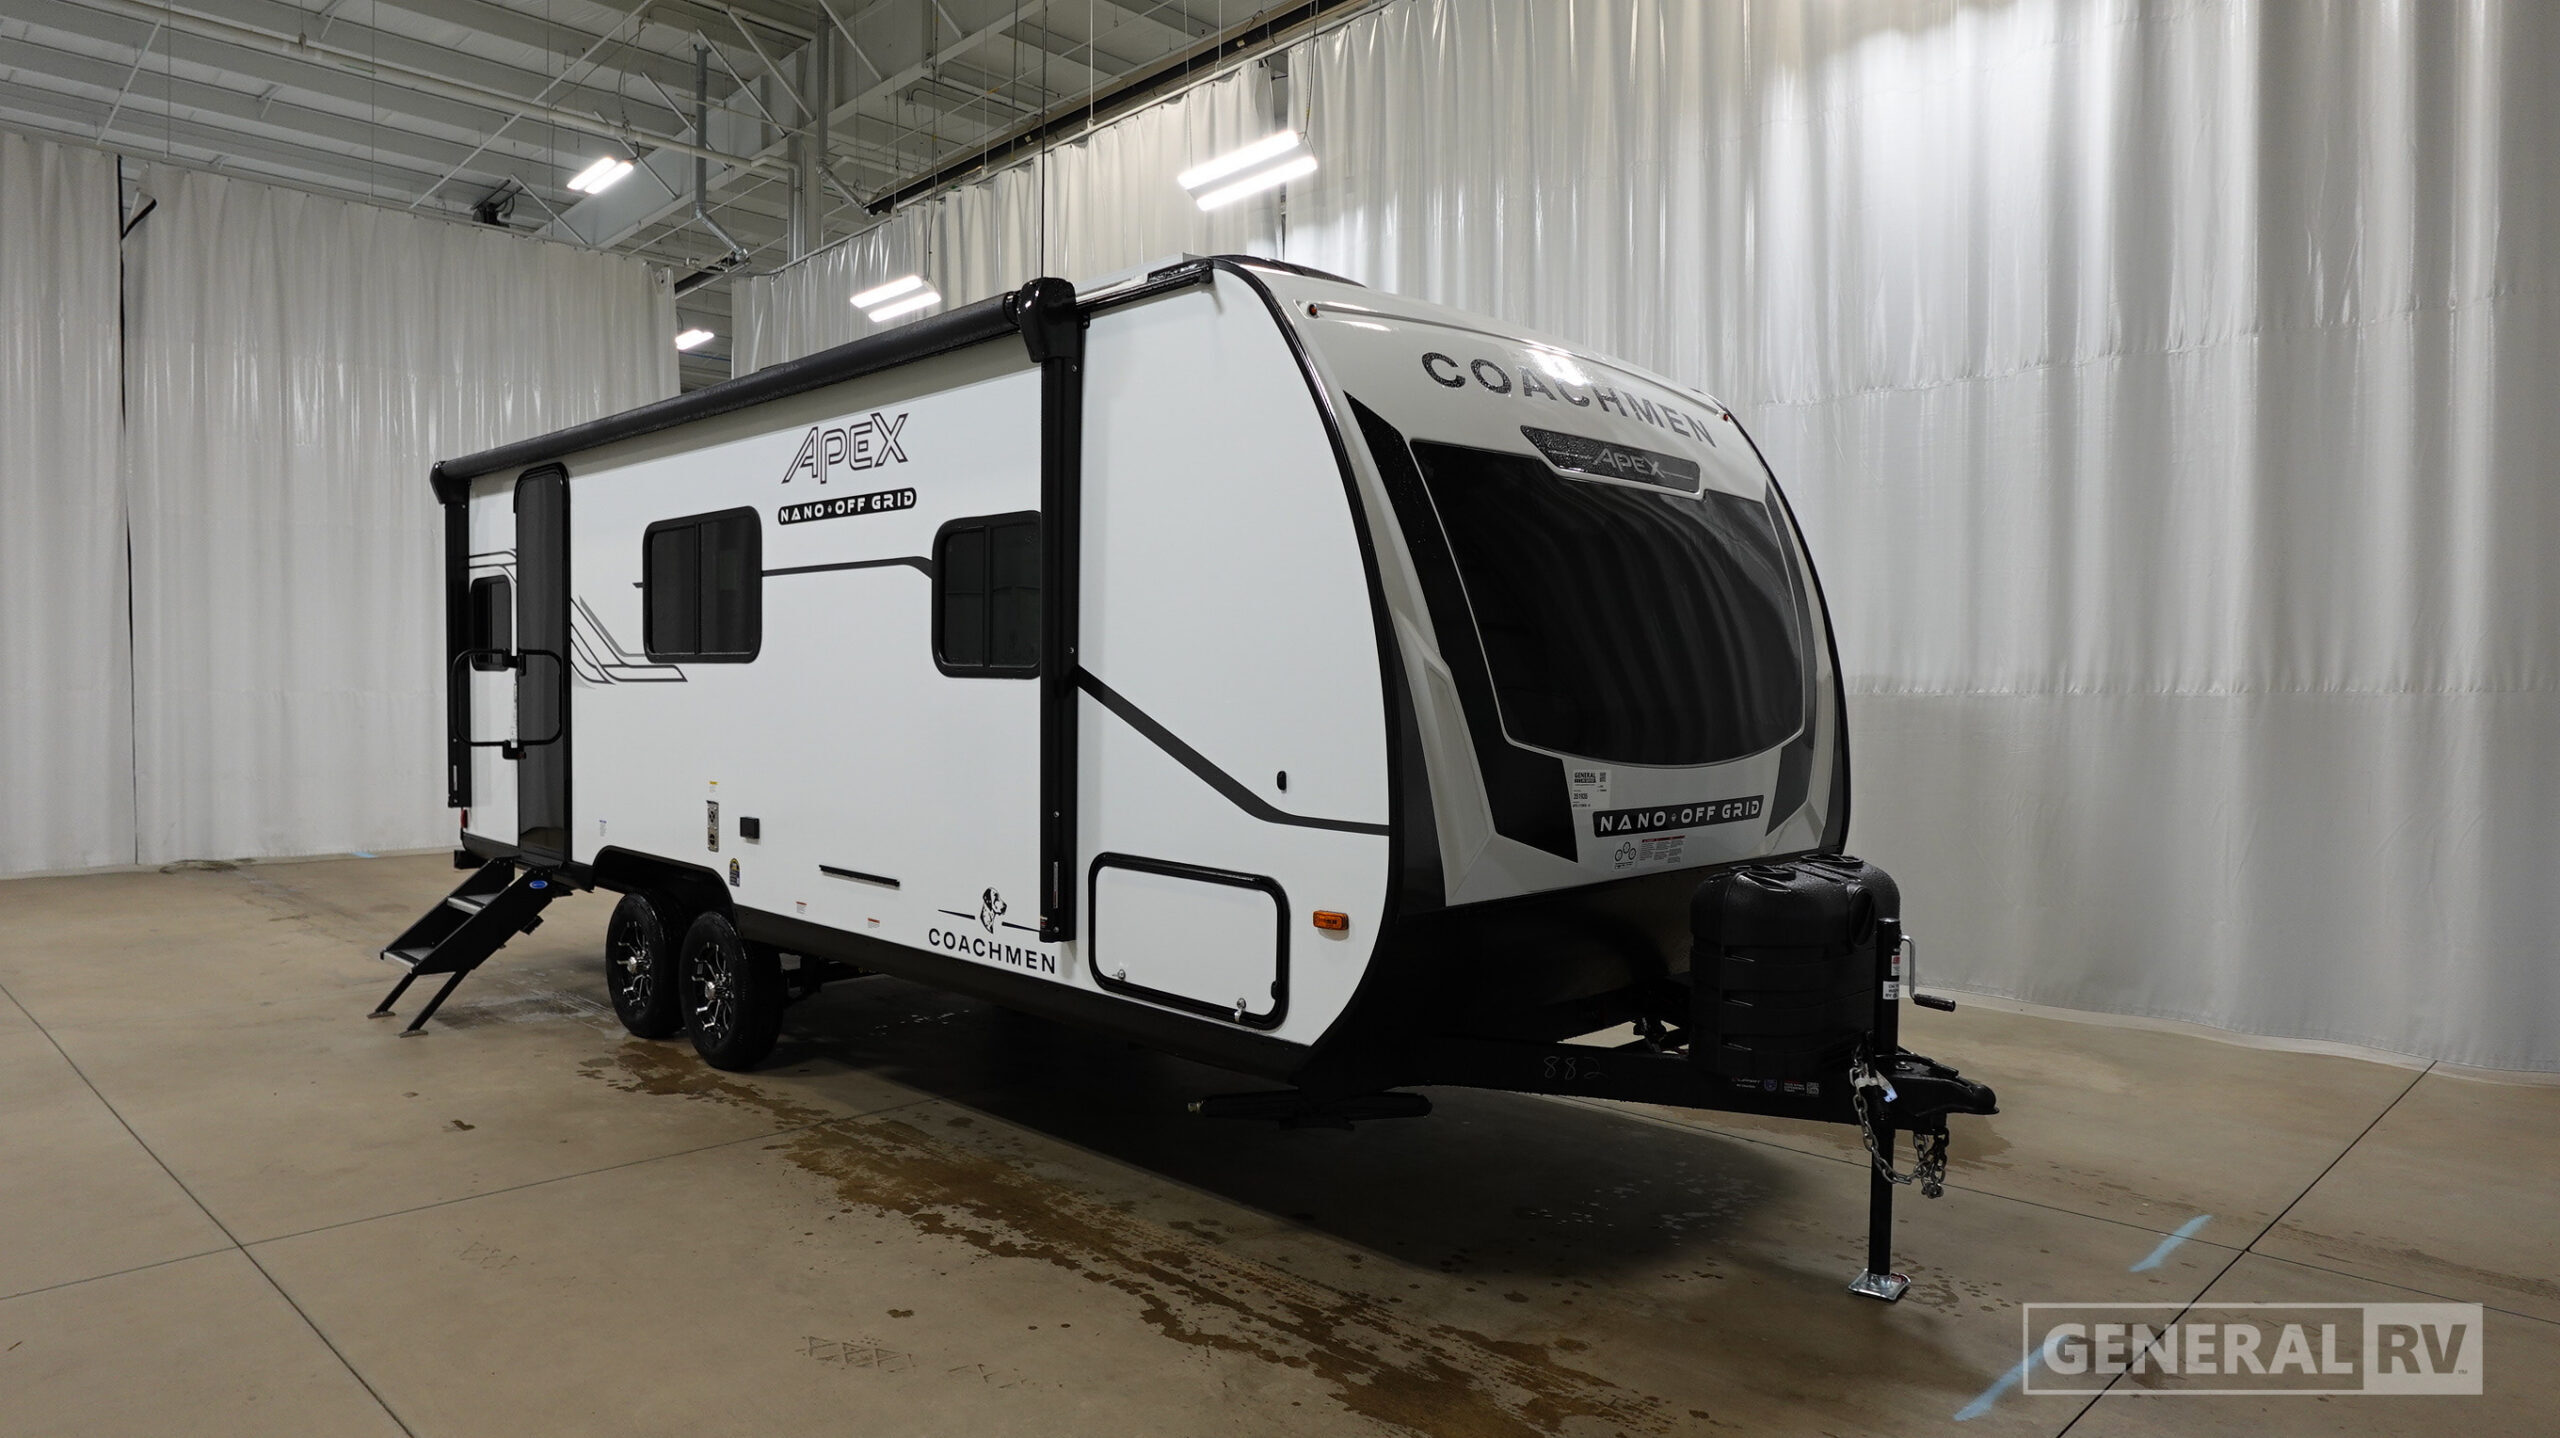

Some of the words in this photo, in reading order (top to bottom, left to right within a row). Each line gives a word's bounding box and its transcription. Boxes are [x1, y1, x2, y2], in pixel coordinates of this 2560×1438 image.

[1421, 351, 1717, 448] COACHMEN
[781, 412, 909, 484] APEX
[1593, 448, 1665, 478] APEX
[780, 503, 824, 523] NANO
[835, 497, 865, 515] OFF
[871, 491, 915, 510] GRID
[1600, 811, 1667, 832] NANO
[1681, 806, 1715, 824] OFF
[1722, 800, 1760, 819] GRID
[928, 928, 1055, 974] COACHMEN
